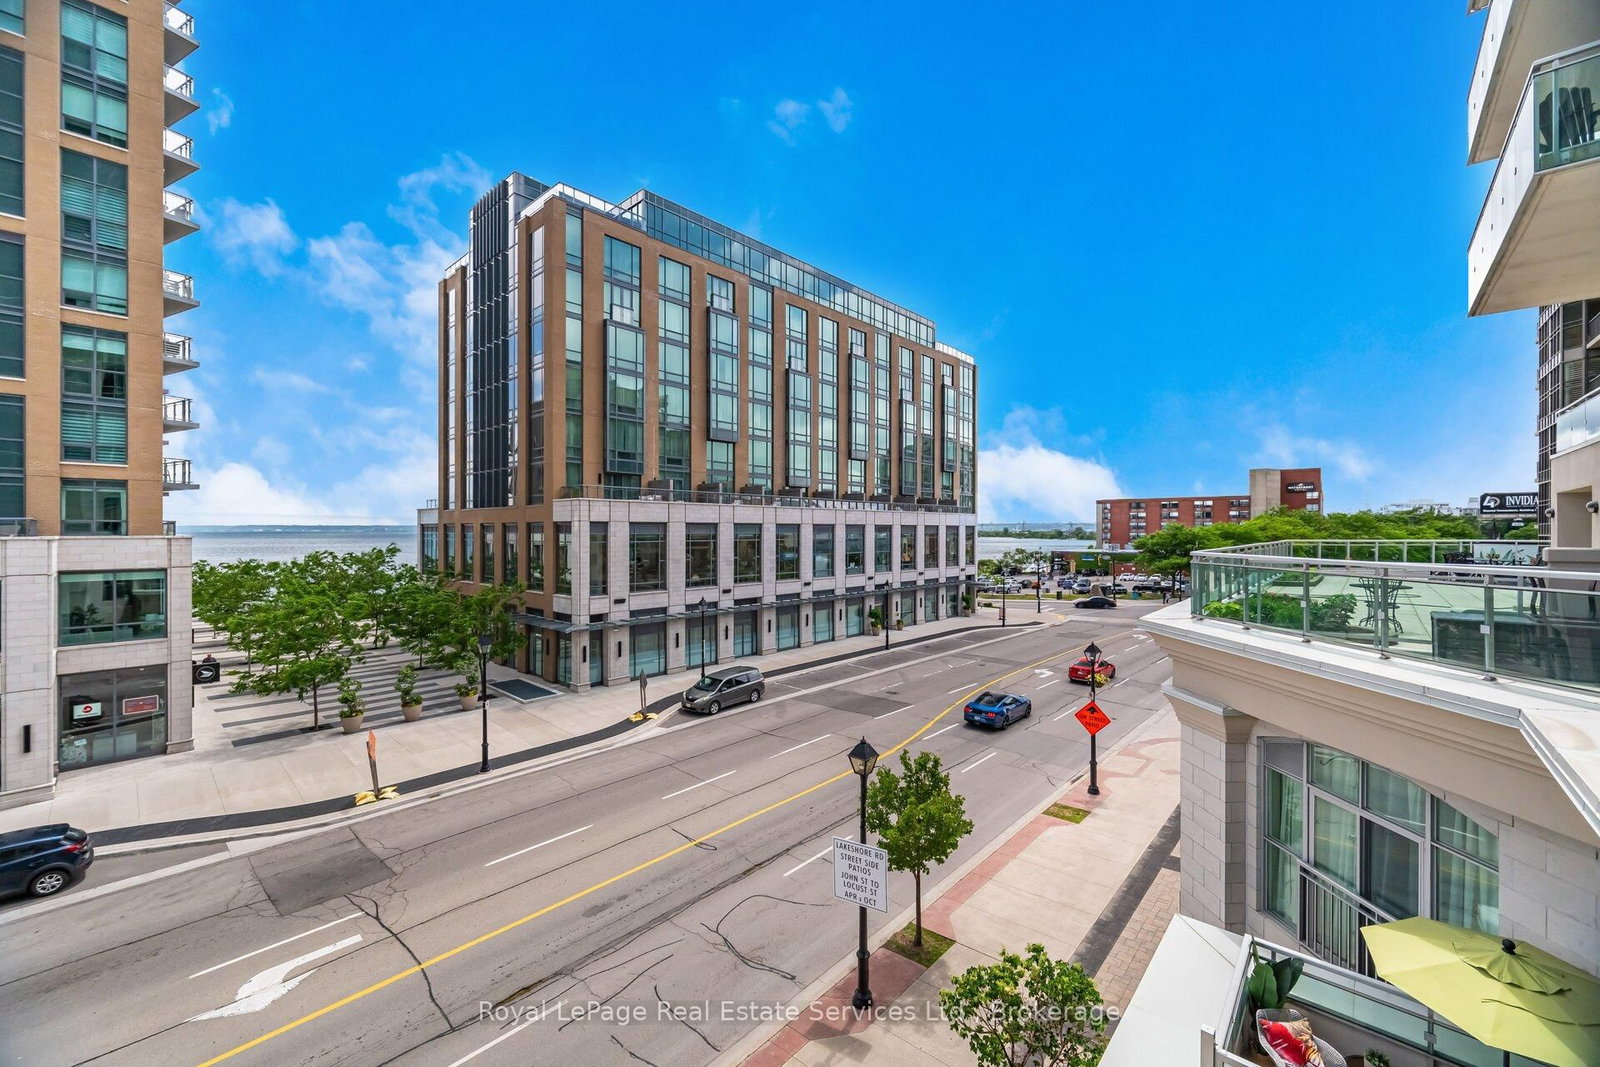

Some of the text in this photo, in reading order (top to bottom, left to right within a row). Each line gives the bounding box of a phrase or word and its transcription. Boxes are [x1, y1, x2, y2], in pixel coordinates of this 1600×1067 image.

[836, 842, 884, 861] LAKESHORE RD
[840, 853, 880, 870] STREET SIDE
[849, 864, 872, 876] PATIOS
[841, 871, 879, 888] JOHN ST TO
[843, 881, 867, 893] LOCUST
[844, 891, 857, 900] APR
[864, 897, 876, 906] OCT
